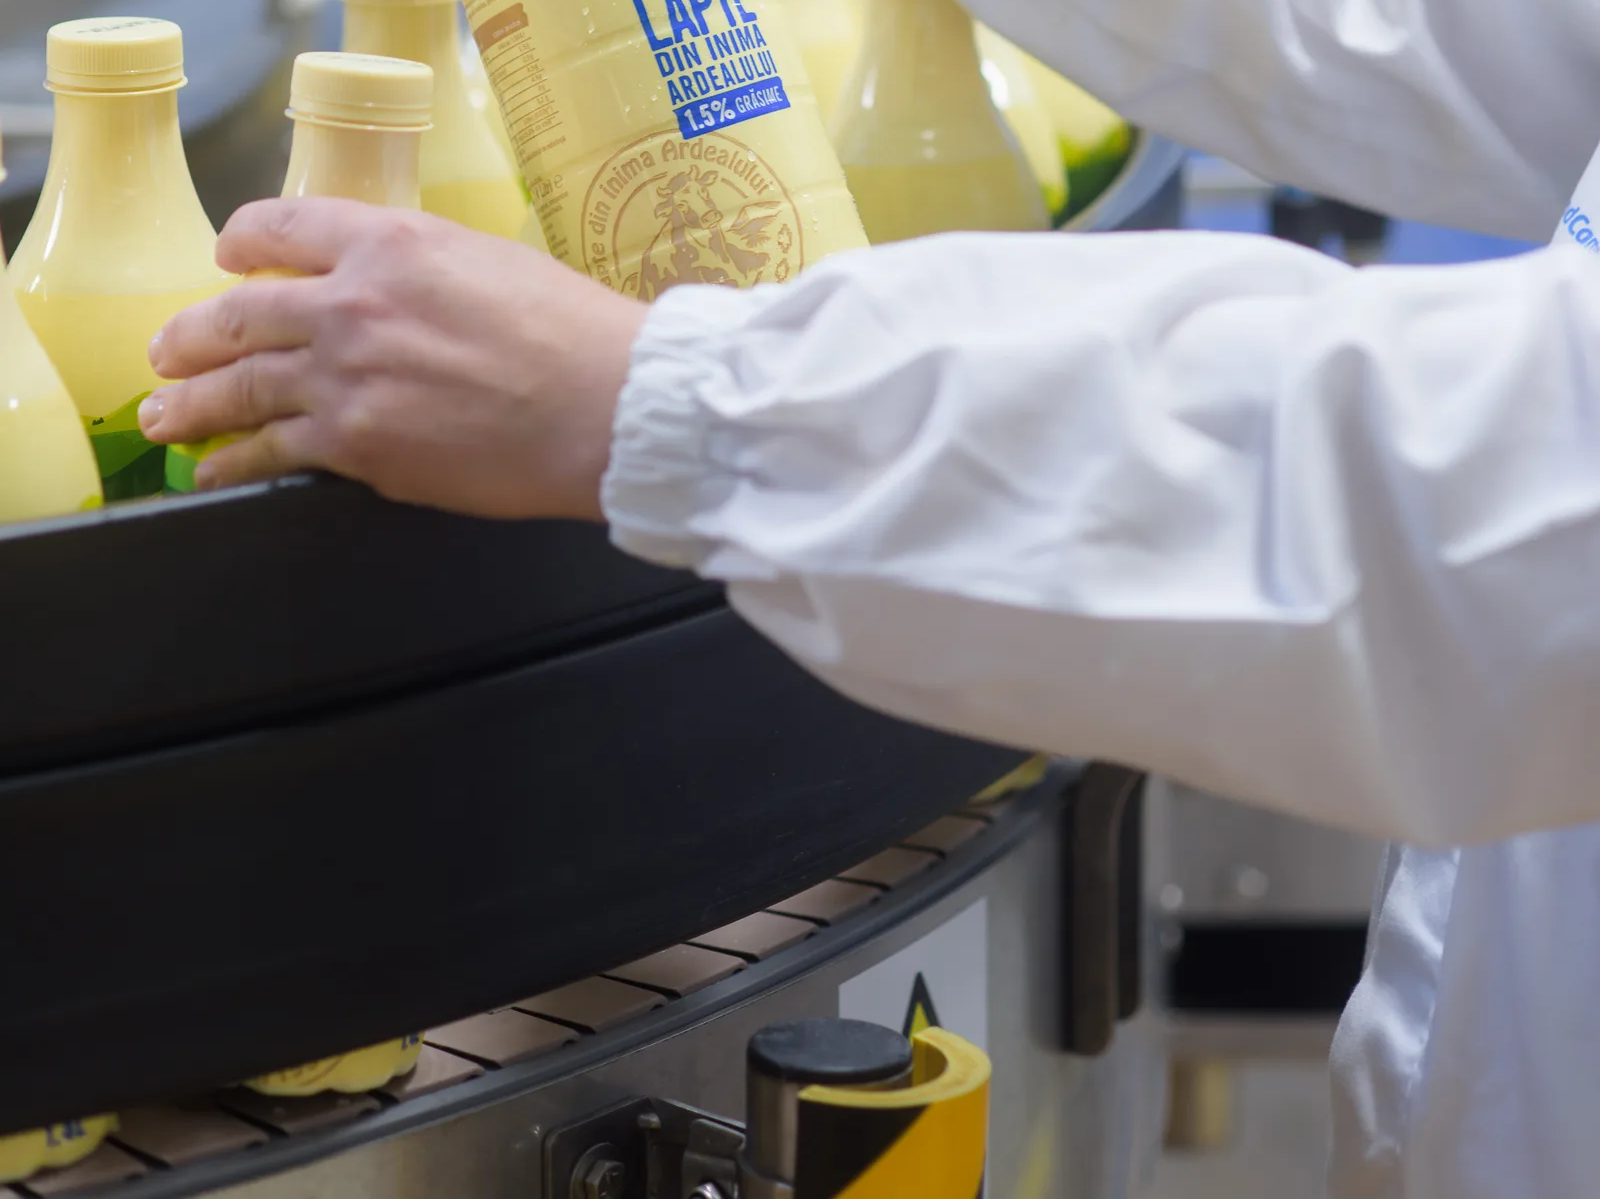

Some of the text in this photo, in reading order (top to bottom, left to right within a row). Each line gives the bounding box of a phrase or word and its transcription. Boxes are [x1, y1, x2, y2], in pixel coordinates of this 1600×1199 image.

[654, 23, 767, 78] DIN INIMA
[667, 50, 778, 106] ARDEALULUI
[684, 85, 783, 131] 1.5% GRĂSIME
[599, 150, 655, 200] inima
[661, 138, 772, 196] Ardealului
[588, 204, 611, 235] din
